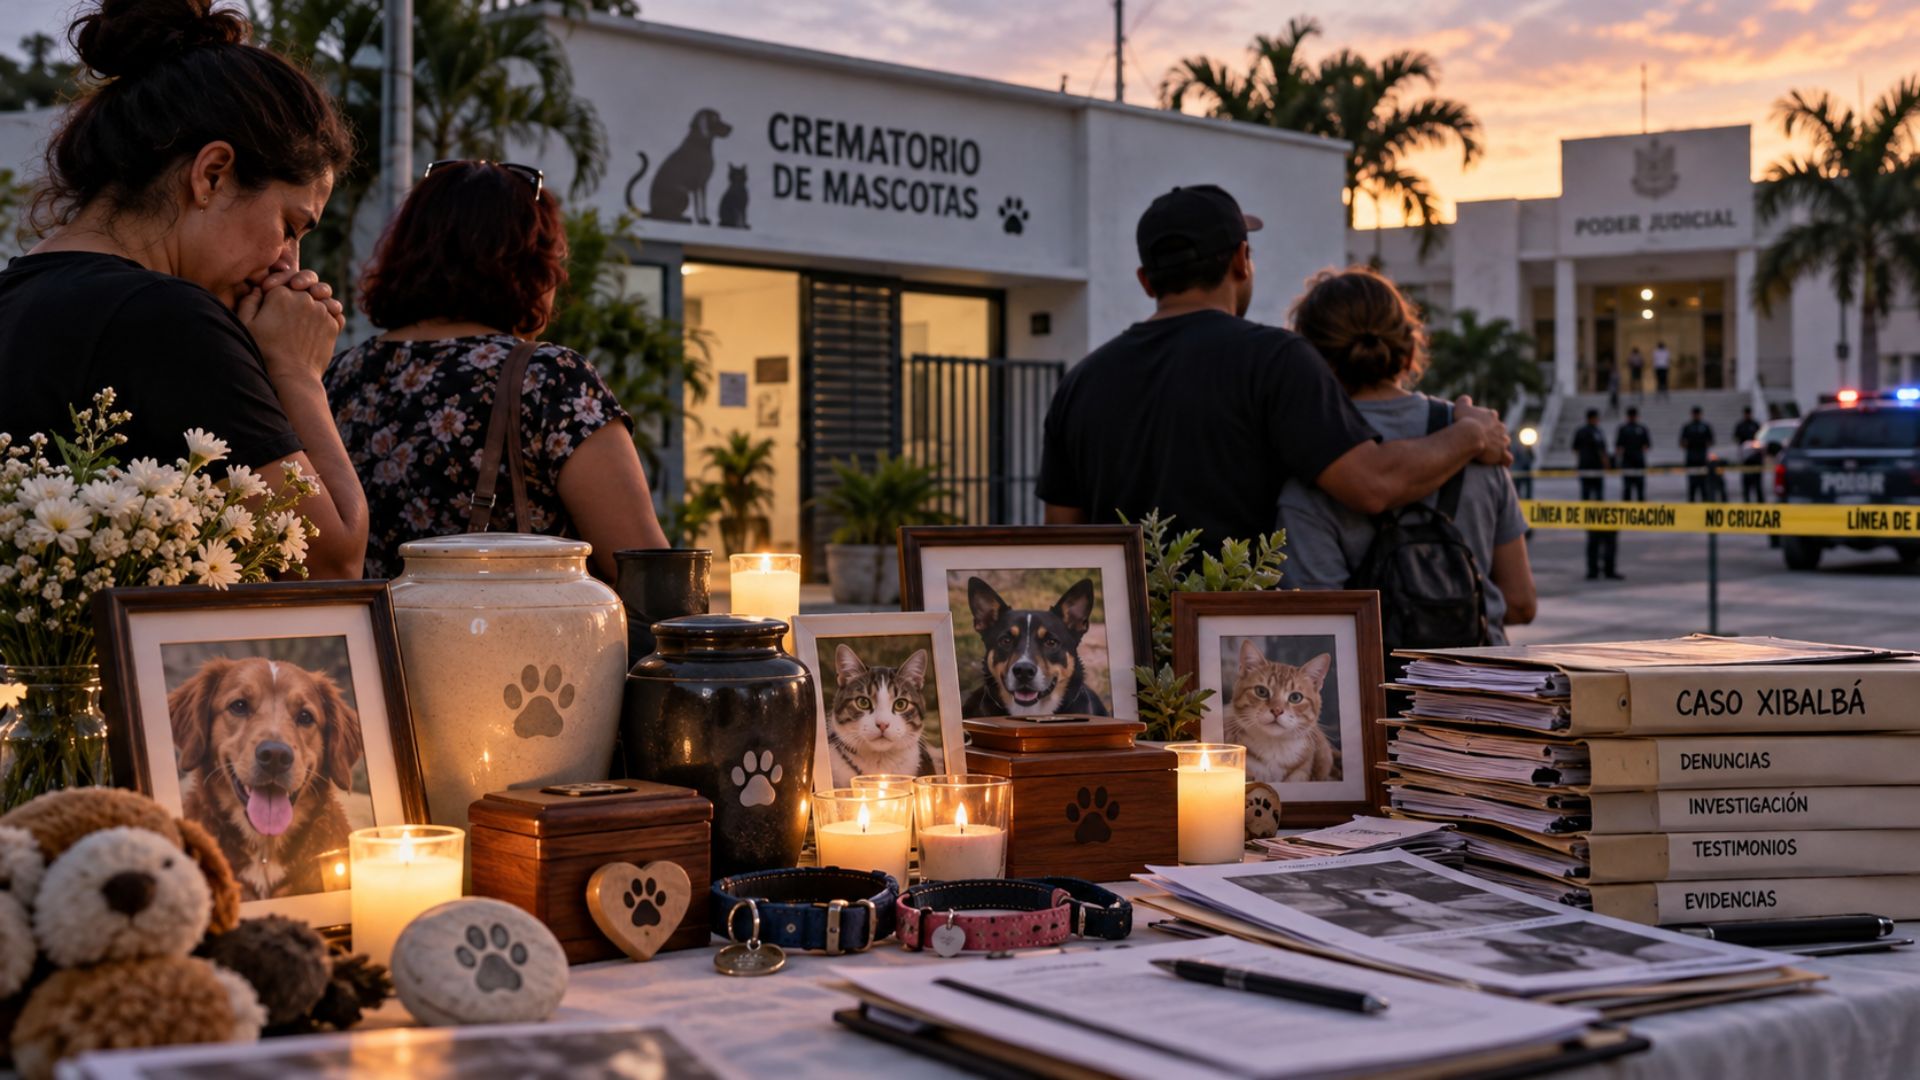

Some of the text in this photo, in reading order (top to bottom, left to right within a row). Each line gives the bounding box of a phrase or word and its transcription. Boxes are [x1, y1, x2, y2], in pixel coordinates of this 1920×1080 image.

[768, 111, 981, 177] CREMATORIO
[773, 163, 980, 219] DE MASCOTAS
[1575, 209, 1737, 236] PODER JUDICIAL
[1530, 504, 1561, 523] LÍNEA
[1566, 506, 1580, 524] DE
[1584, 505, 1675, 526] INVESTIGACIÓN
[1705, 508, 1723, 527] NO
[1727, 509, 1781, 528] CRUZAR
[1847, 507, 1889, 530] LÍNEA
[1893, 511, 1912, 530] DE
[1676, 679, 1866, 716] CASO XIBALBÁ
[1681, 751, 1771, 771] DENUNCIAS
[1688, 791, 1808, 815] INVESTIGACIÓN
[1692, 838, 1798, 858] TESTIMONIOS
[1684, 889, 1777, 910] EVIDENCIAS
